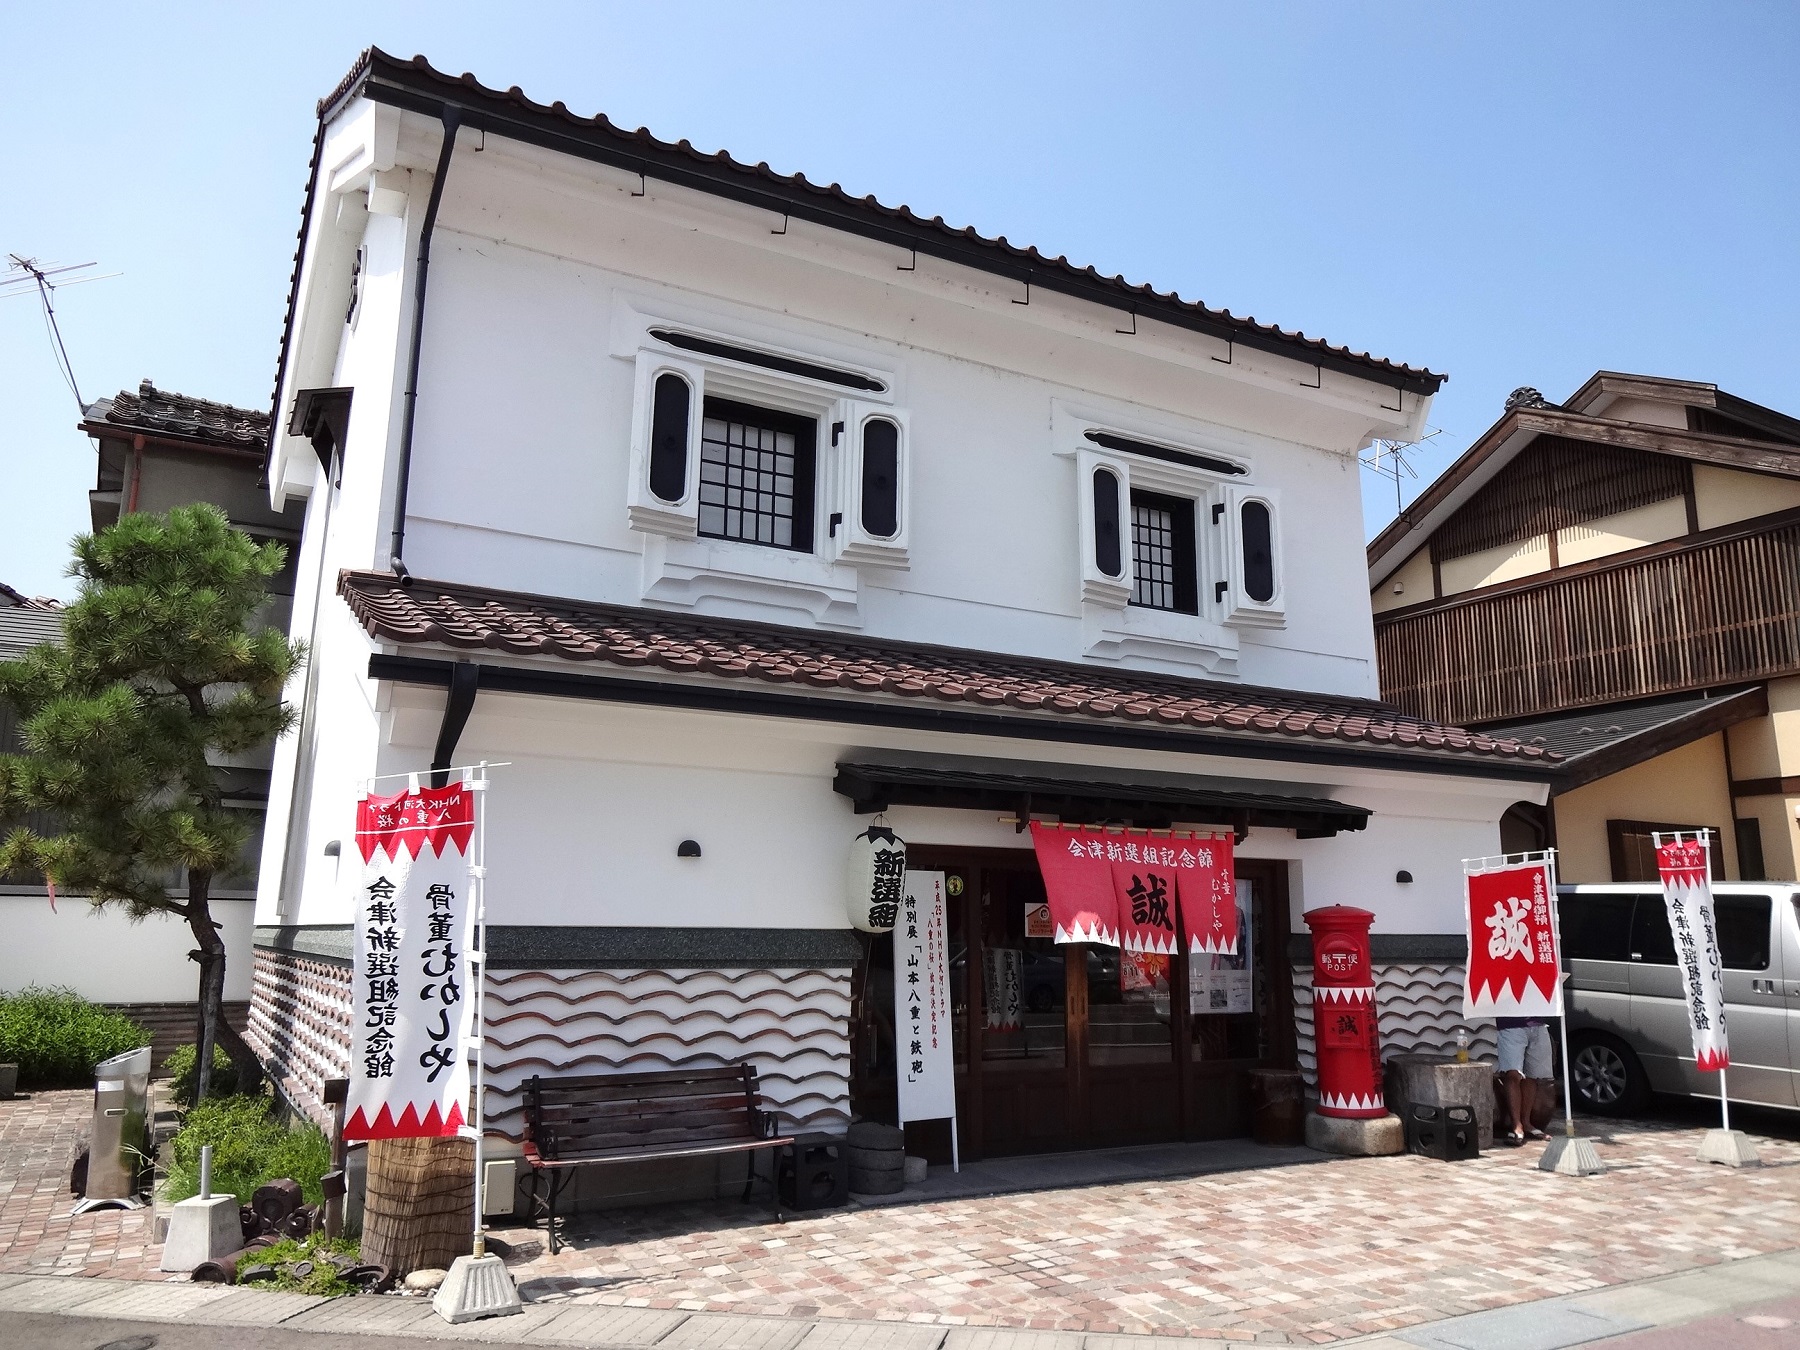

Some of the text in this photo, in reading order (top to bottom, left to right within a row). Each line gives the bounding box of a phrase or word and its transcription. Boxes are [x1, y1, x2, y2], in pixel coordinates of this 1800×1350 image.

[1067, 837, 1213, 868] 会津新選組記念館
[868, 848, 904, 928] 新選組
[1125, 872, 1174, 932] 誠
[1211, 878, 1223, 932] むかしや
[1220, 868, 1231, 895] 骨董
[1484, 896, 1535, 965] 誠
[1336, 1014, 1359, 1036] 誠
